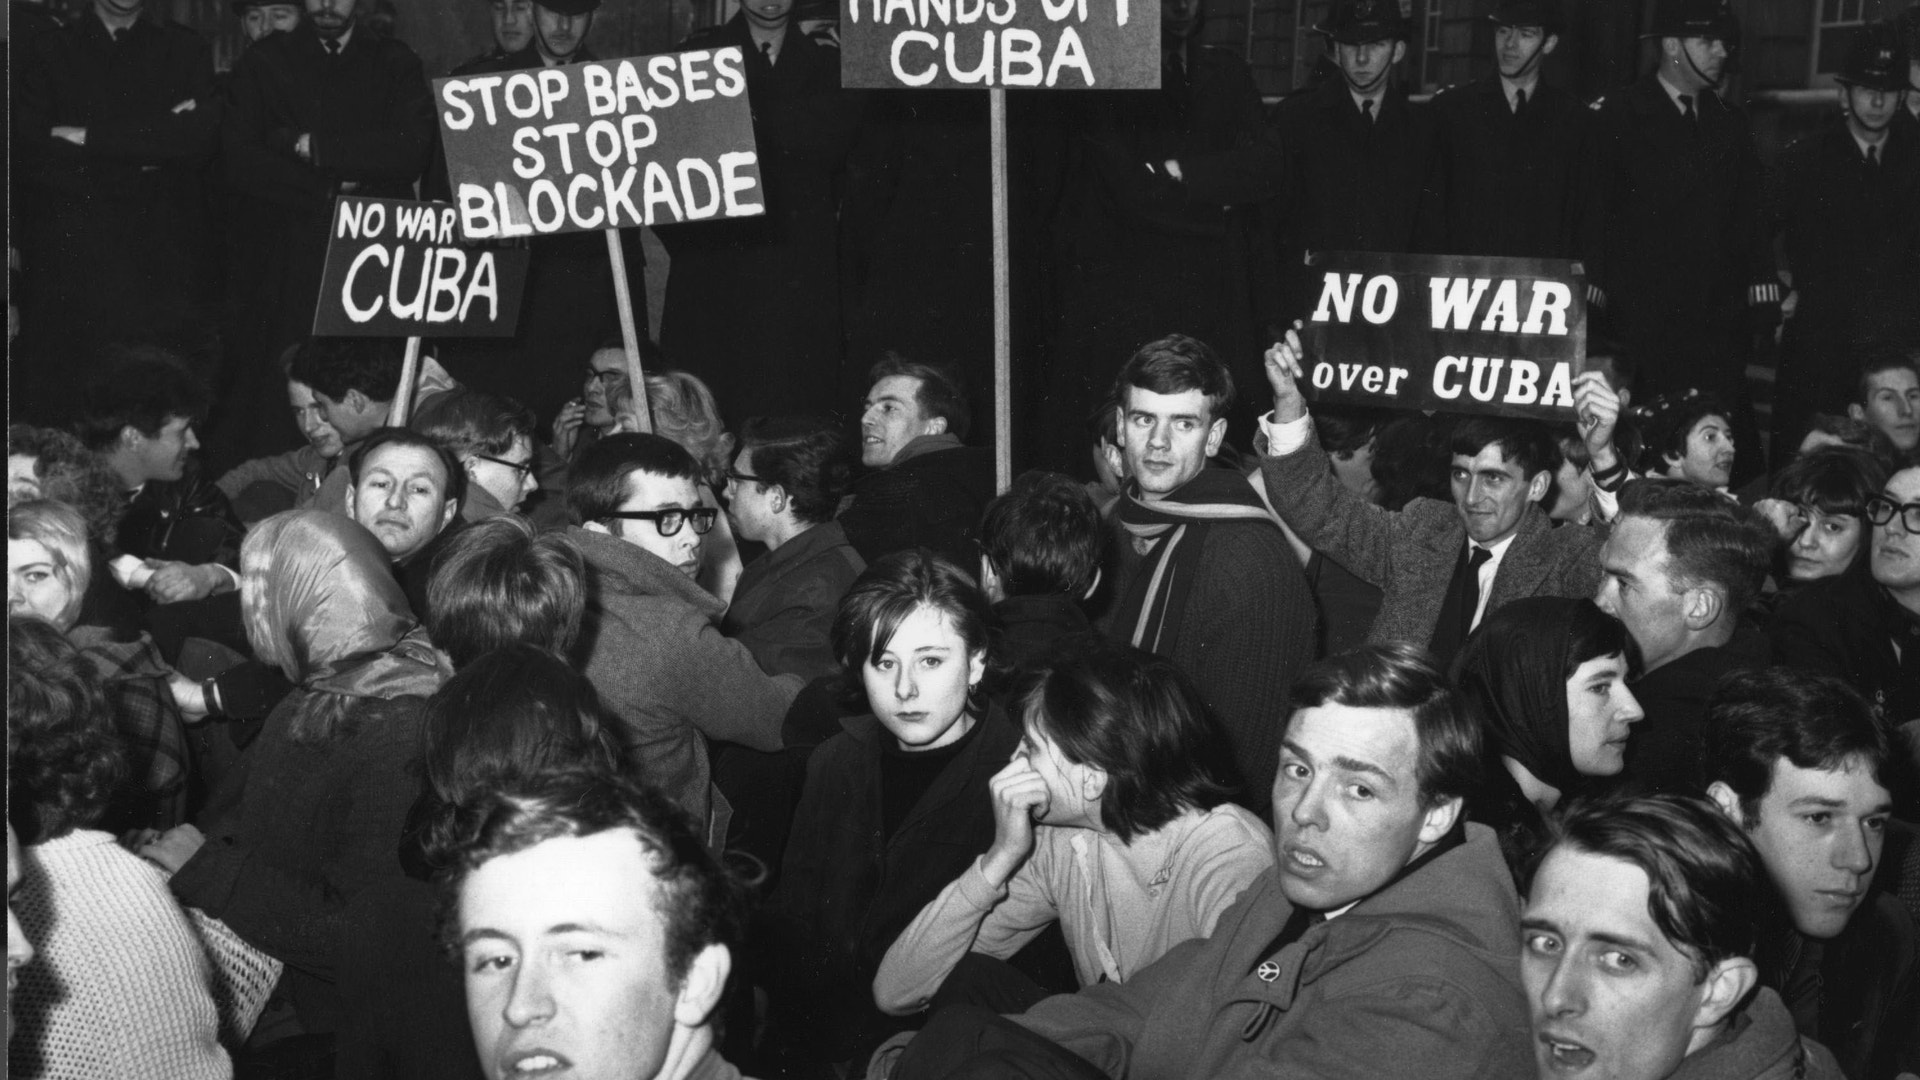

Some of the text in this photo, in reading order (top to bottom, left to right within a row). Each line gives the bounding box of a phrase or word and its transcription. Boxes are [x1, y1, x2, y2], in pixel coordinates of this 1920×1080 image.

[890, 26, 1095, 87] CUBA
[442, 47, 746, 131] STOP BASES
[512, 114, 657, 179] STOP
[338, 201, 457, 244] NO WAR
[457, 151, 764, 238] BLOCKADE
[342, 244, 497, 322] CUBA
[1312, 272, 1572, 335] NO WAR
[1312, 356, 1575, 407] over CUBA
